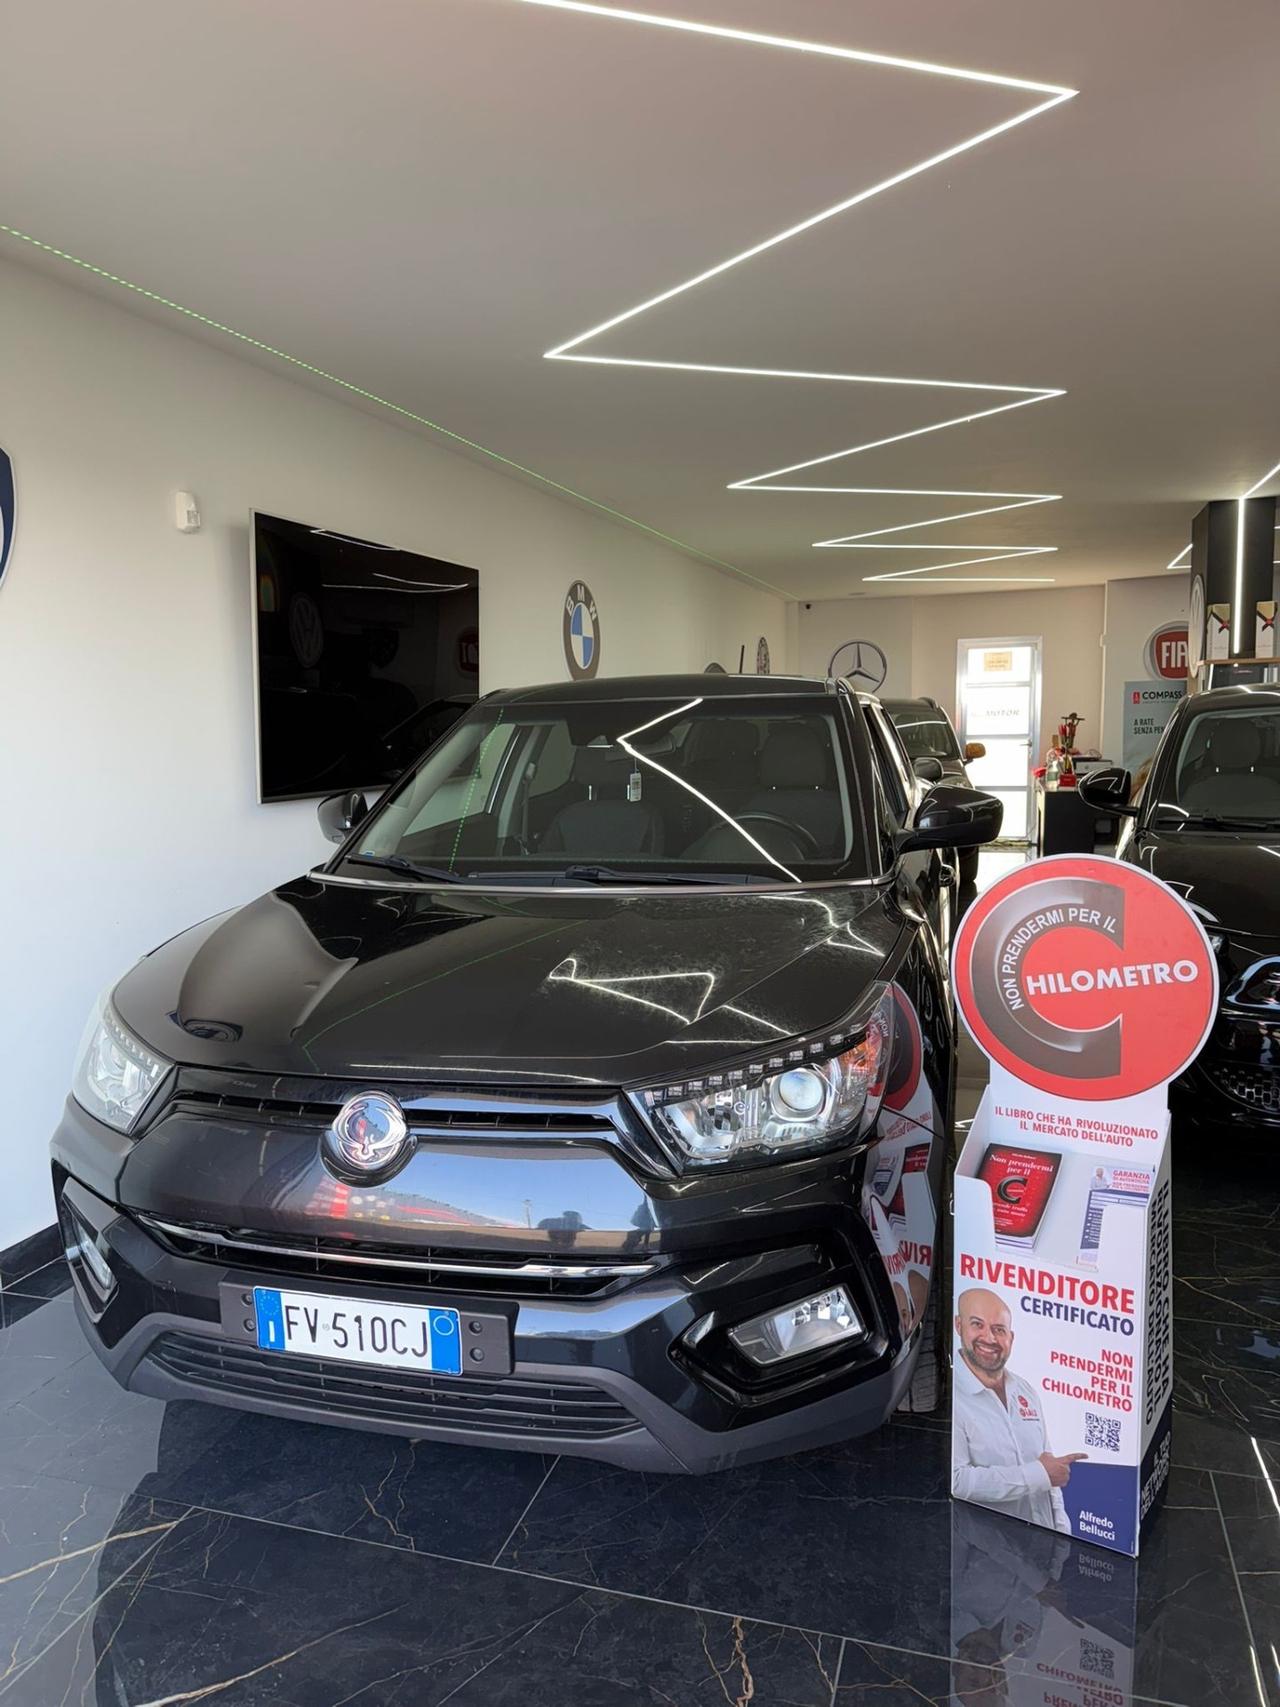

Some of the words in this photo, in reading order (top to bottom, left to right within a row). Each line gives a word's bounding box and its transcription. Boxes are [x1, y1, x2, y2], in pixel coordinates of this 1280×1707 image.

[566, 584, 597, 621] BMW
[1161, 641, 1189, 669] FIA
[1142, 691, 1183, 700] COMPASS
[1133, 718, 1139, 726] A
[1140, 718, 1154, 726] RATE
[1133, 727, 1153, 735] SENZA
[1154, 727, 1165, 735] PEN
[1068, 907, 1102, 925] PER
[1103, 915, 1117, 934] IL
[1002, 908, 1065, 974] PRENDERMI
[1026, 959, 1199, 996] HILOMETRO
[1003, 978, 1025, 1011] NON
[995, 1106, 1005, 1116] IL
[1005, 1107, 1034, 1121] LIBRO
[1036, 1112, 1056, 1124] CHE
[1057, 1115, 1072, 1126] HA
[1076, 1118, 1159, 1140] RIVOLUZIONATO
[1019, 1120, 1029, 1131] IL
[1032, 1122, 1079, 1139] MERCATO
[1081, 1130, 1134, 1147] DELL'AUTO
[990, 1154, 1007, 1164] Non
[1008, 1160, 1054, 1173] prendermi
[1006, 1166, 1022, 1174] per
[1023, 1168, 1031, 1176] il
[1113, 1169, 1150, 1180] GARANZIA
[1149, 1199, 1157, 1306] MERCATO
[961, 1253, 1135, 1314] RIVENDITORE
[1155, 1187, 1163, 1383] RIVOLUZIONATO
[285, 1305, 318, 1343] FV
[331, 1312, 428, 1357] 510CJ
[1021, 1296, 1134, 1336] CERTIFICATO
[1051, 1351, 1133, 1383] PRENDERMI
[1101, 1349, 1133, 1368] NON
[1146, 1309, 1155, 1425] DELL'AUTO
[1091, 1376, 1117, 1393] PER
[1121, 1383, 1133, 1398] IL
[1162, 1354, 1169, 1398] HA
[1042, 1378, 1132, 1412] CHILOMETRO
[1079, 1510, 1114, 1529] Alfredo
[1079, 1521, 1115, 1541] Bellucci
